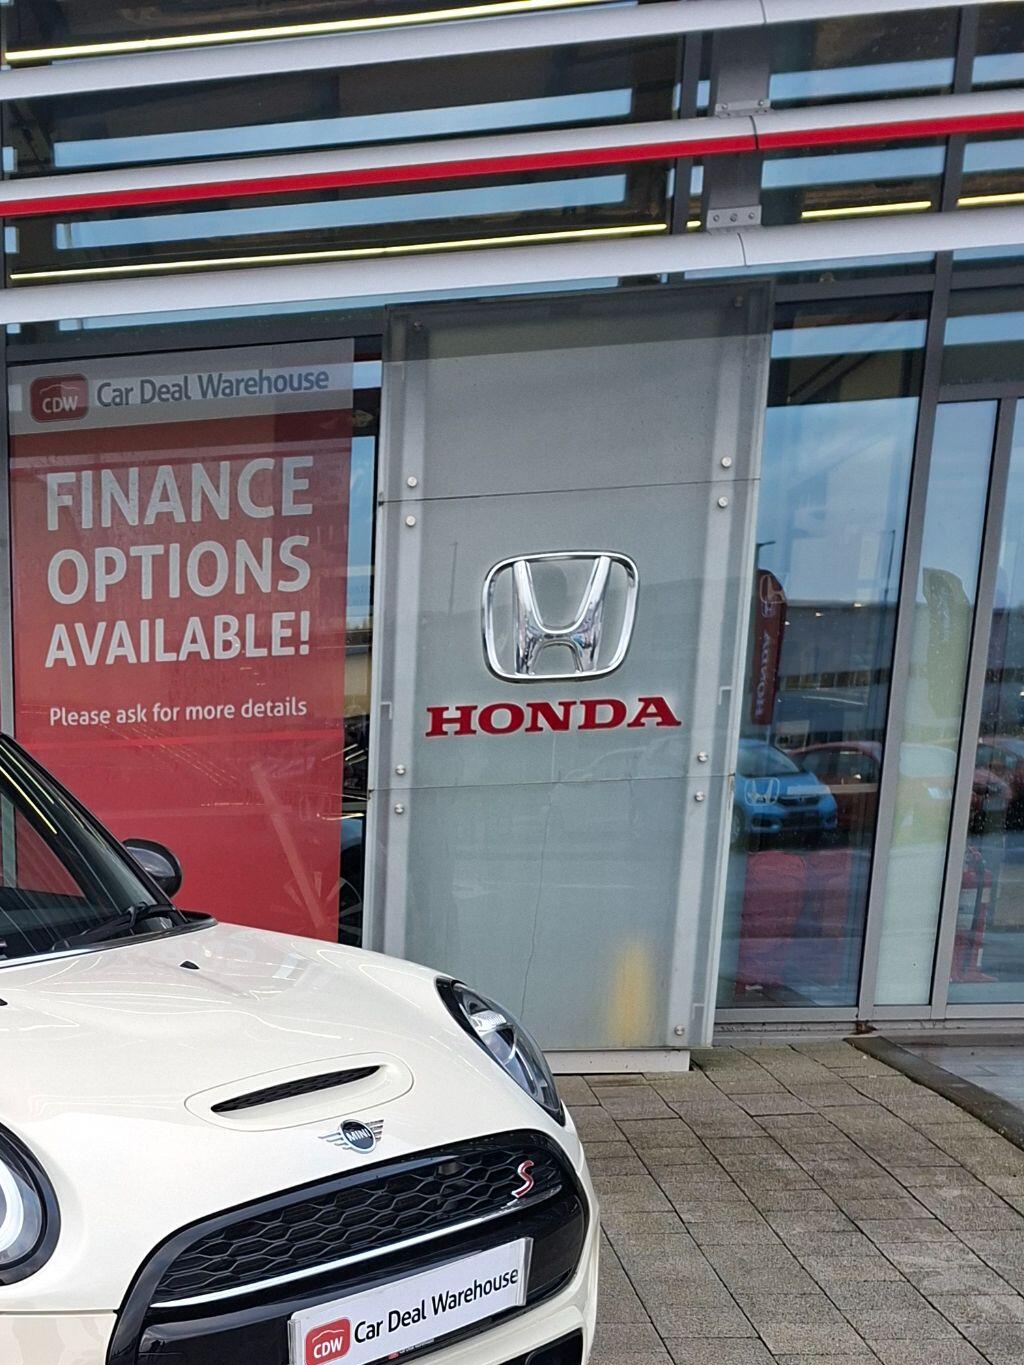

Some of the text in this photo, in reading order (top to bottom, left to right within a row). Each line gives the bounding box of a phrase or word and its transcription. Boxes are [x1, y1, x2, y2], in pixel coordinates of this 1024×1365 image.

[42, 369, 330, 414] CDW Car Deal Warehouse
[46, 455, 314, 531] FINANCE
[47, 535, 312, 605] OPTIONS
[44, 610, 312, 669] AVAILABLE!
[49, 696, 308, 726] Please ask for more details
[425, 695, 682, 738] HONDA
[345, 1128, 372, 1144] MINI
[512, 1159, 535, 1198] S
[313, 1268, 520, 1359] CDW Car Deal Warehouse
